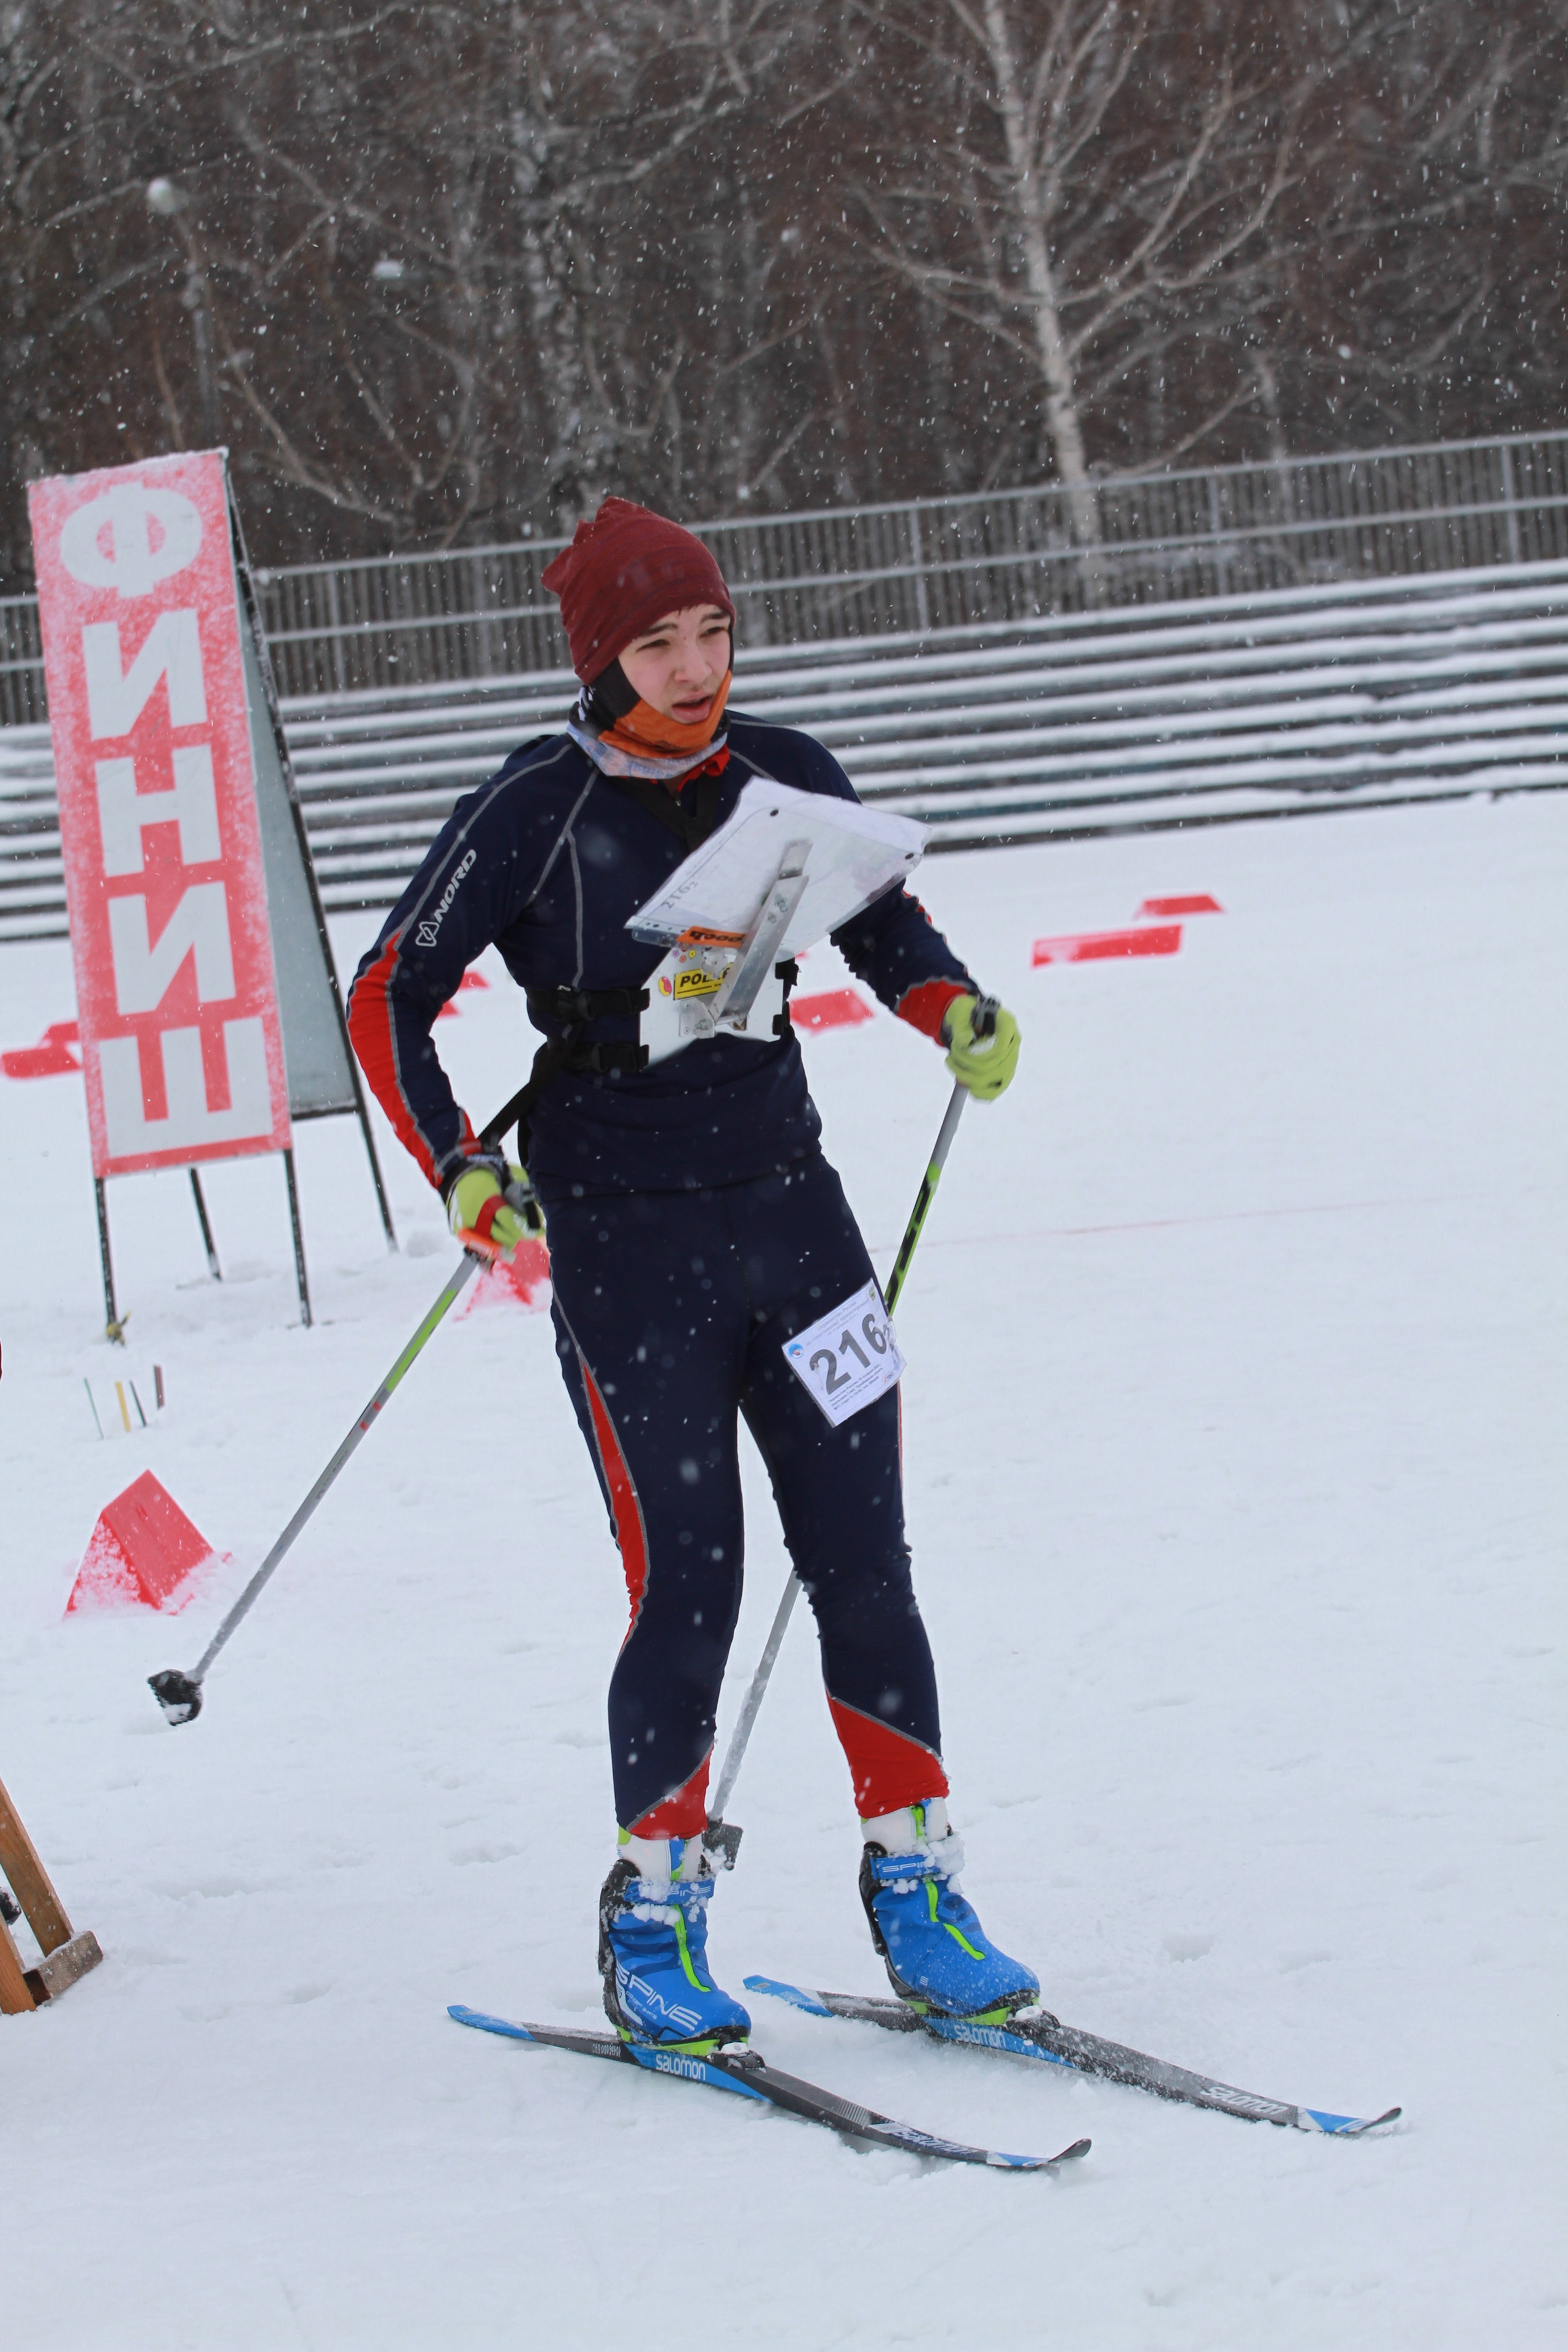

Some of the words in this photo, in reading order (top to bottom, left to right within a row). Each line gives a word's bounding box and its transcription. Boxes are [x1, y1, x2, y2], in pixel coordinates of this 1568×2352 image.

[60, 481, 273, 1158] ФИНИШ
[434, 849, 477, 924] NORD
[809, 1313, 887, 1395] 216
[616, 1962, 703, 2031] SPINE
